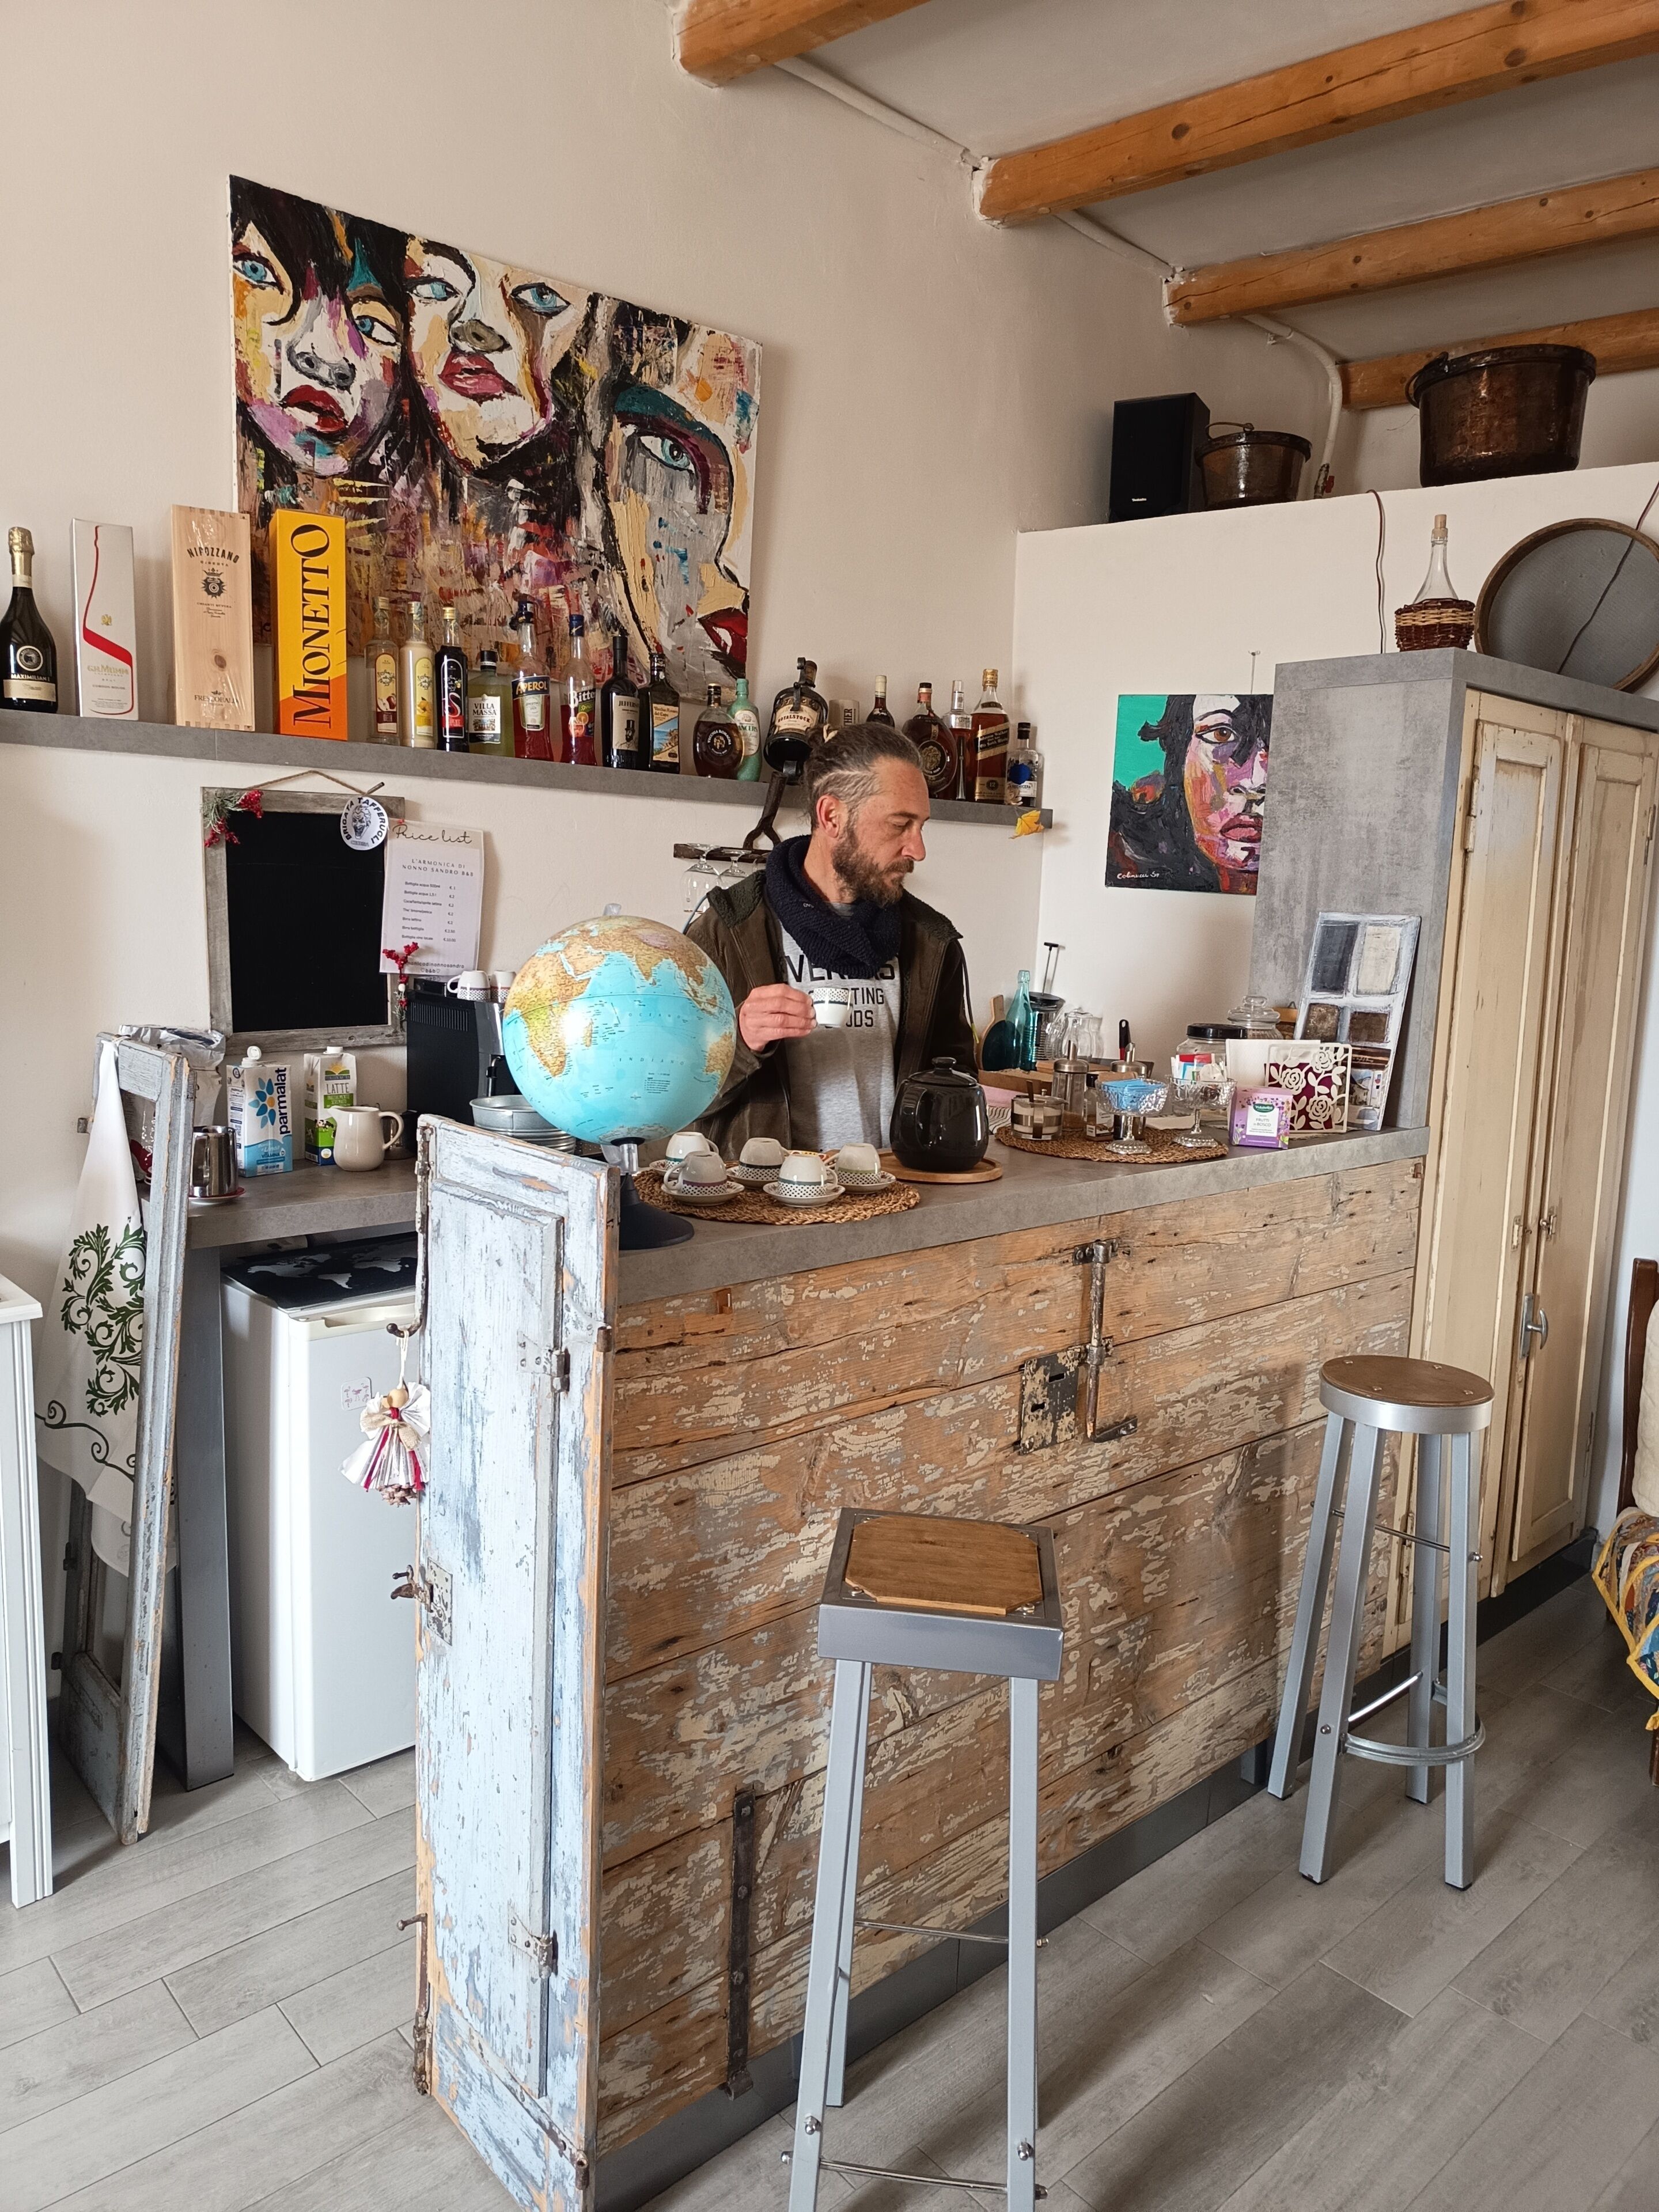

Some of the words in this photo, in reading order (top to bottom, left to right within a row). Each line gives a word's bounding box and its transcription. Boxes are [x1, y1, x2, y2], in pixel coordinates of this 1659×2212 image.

[187, 546, 240, 563] NIPOZZANO
[290, 524, 331, 729] MIONETTO
[516, 681, 548, 695] APEROL
[342, 801, 354, 840] BRIGATA
[392, 824, 439, 841] Price
[441, 830, 472, 844] list
[411, 858, 455, 868] L'ARMONICA
[431, 868, 459, 876] SANDRO
[326, 1082, 350, 1094] LATTE
[274, 1067, 291, 1135] parmalat
